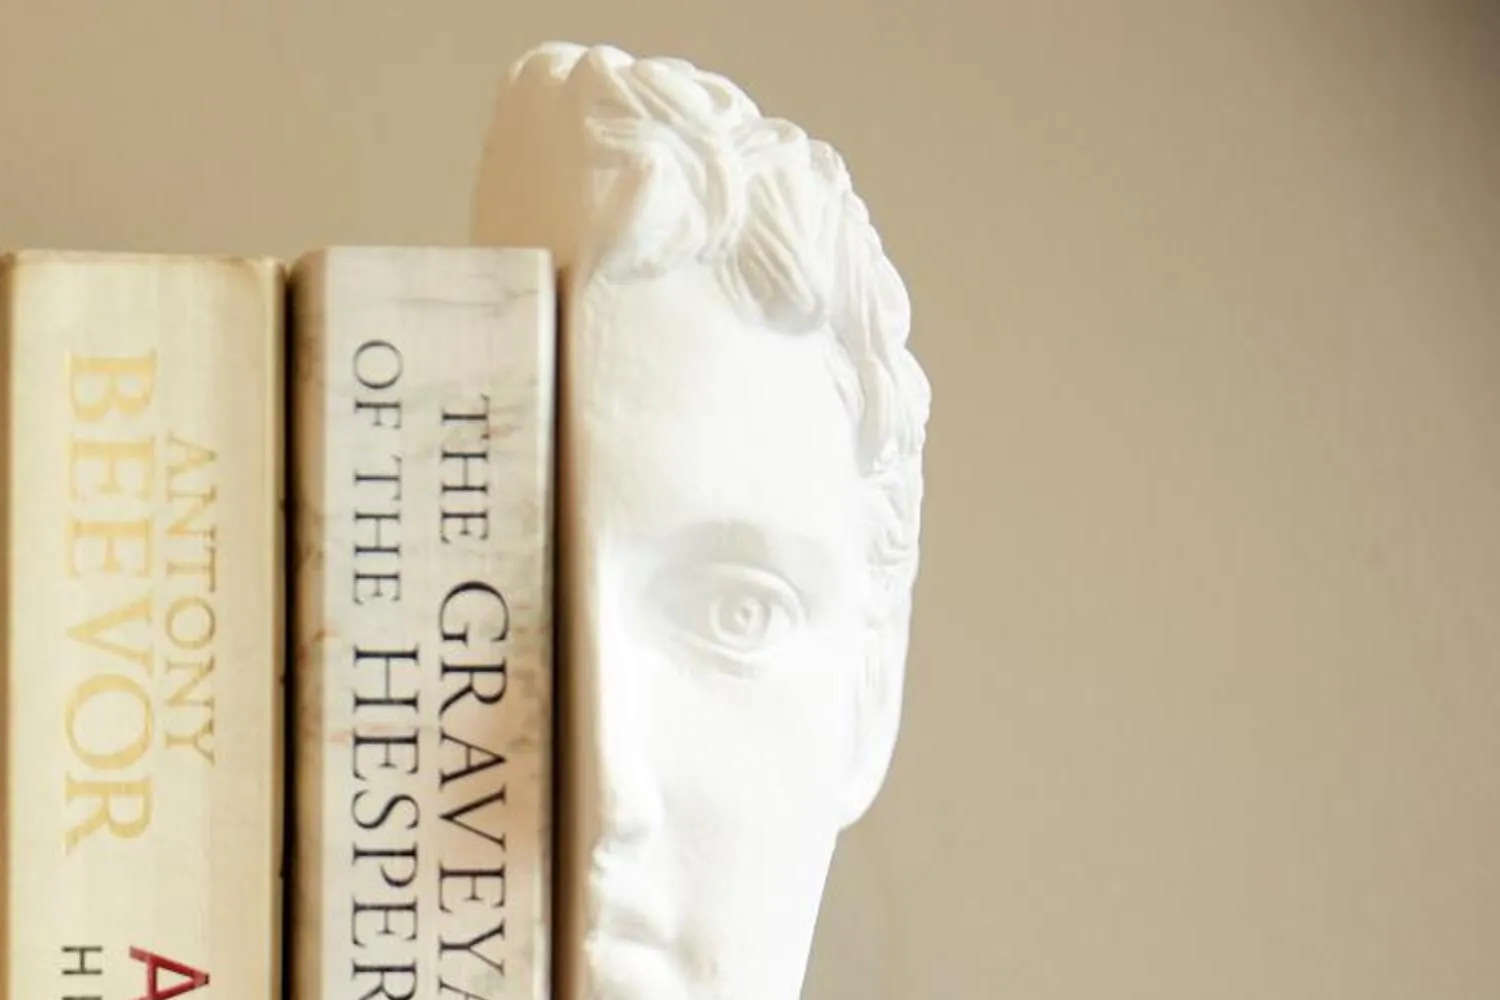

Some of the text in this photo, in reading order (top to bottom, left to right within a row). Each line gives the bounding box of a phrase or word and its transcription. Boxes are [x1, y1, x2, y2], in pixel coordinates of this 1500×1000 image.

[353, 340, 402, 430] OF
[353, 455, 401, 606] THE
[439, 394, 490, 545] THE
[64, 348, 156, 856] BEEVOR
[164, 429, 218, 768] ANTONY
